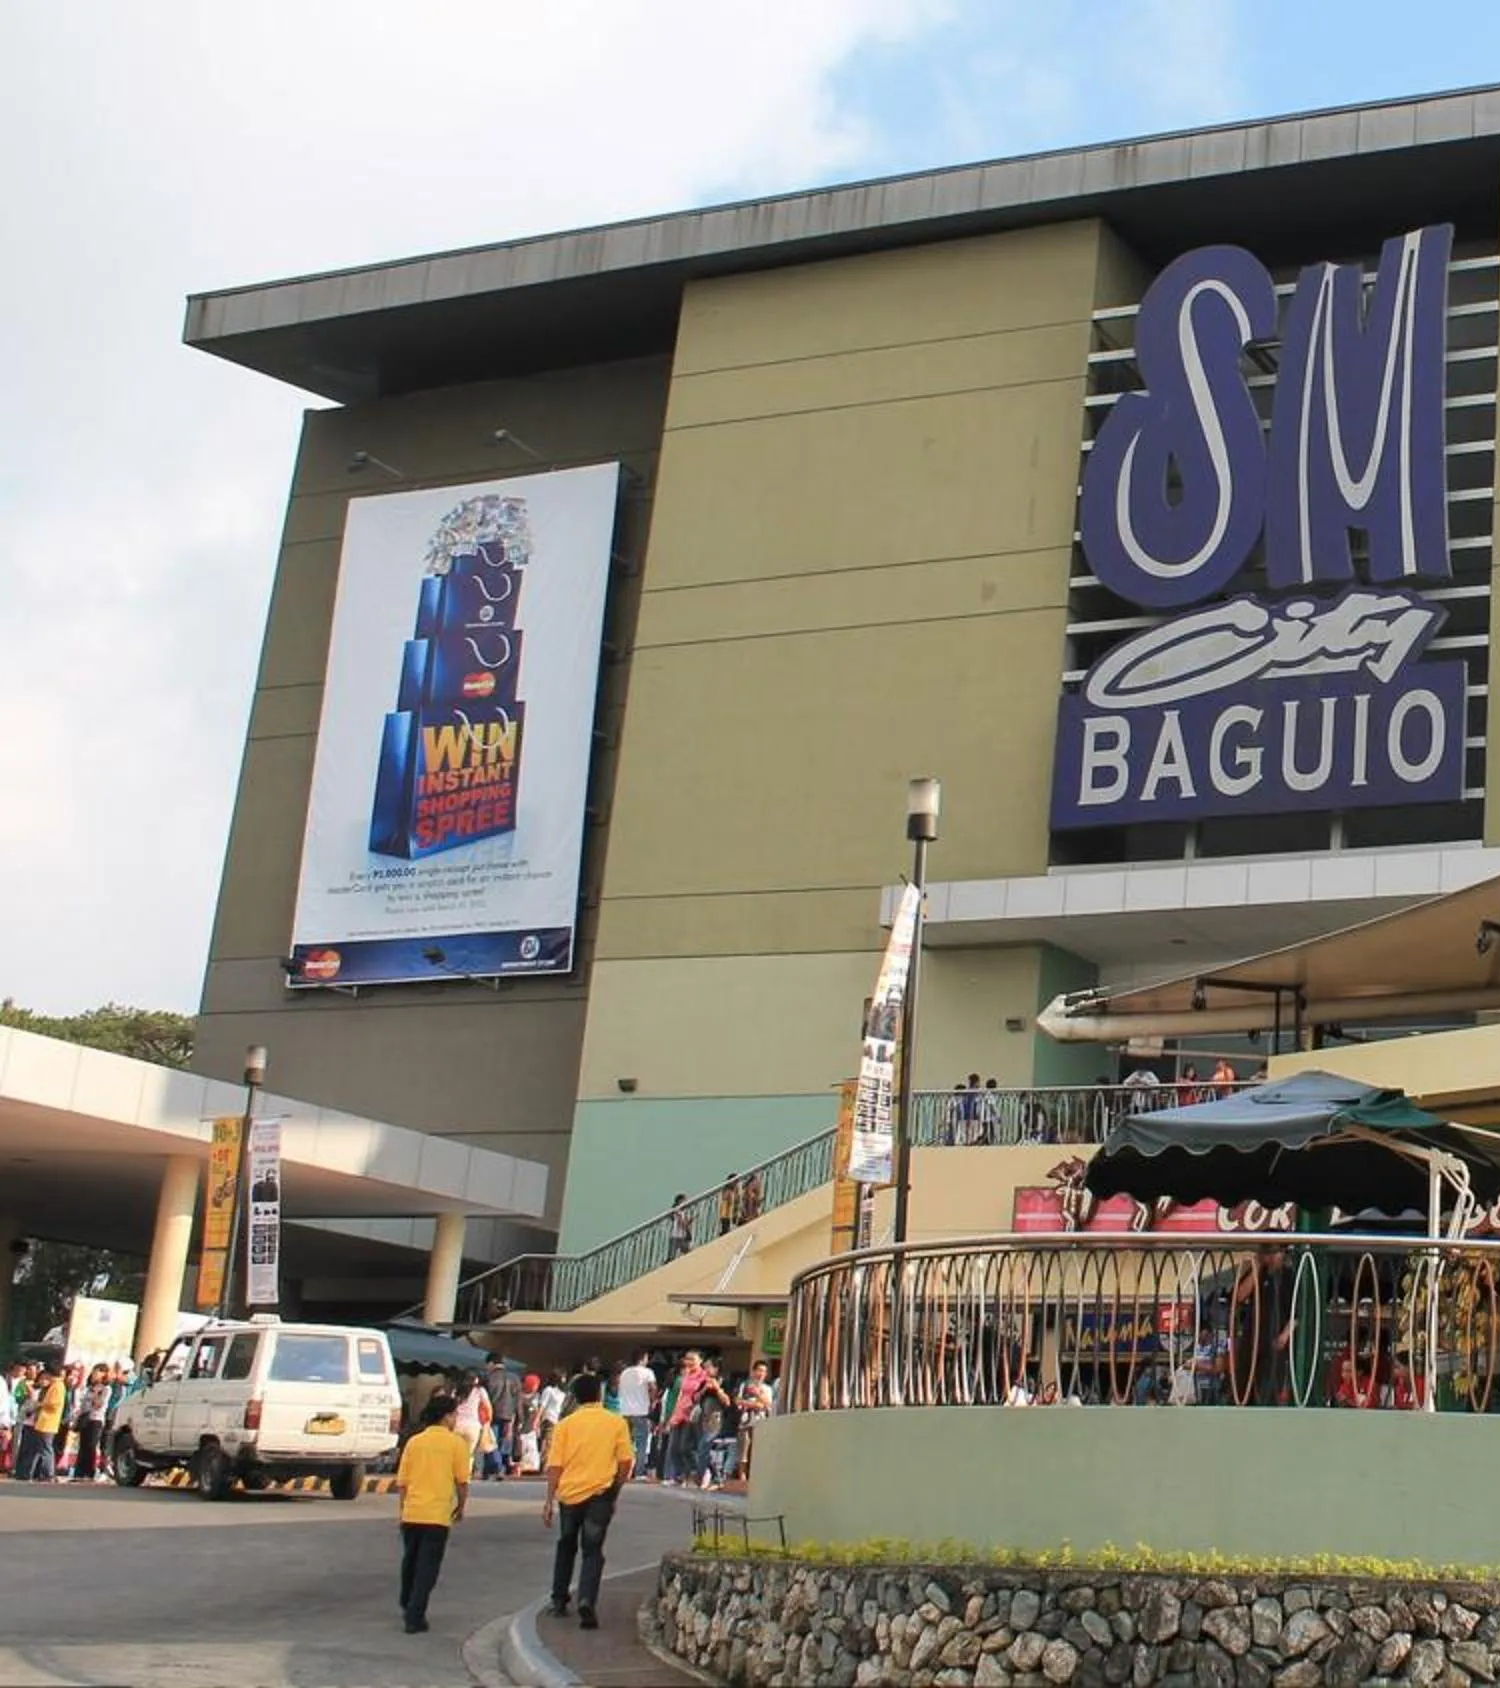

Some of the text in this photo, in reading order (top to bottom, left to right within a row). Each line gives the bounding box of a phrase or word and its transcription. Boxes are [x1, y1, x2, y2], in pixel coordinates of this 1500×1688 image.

[1082, 222, 1455, 607] SM
[1086, 593, 1435, 709] City
[423, 721, 516, 772] WIN
[1077, 689, 1446, 806] BAGUIO
[416, 762, 512, 797] INSTANT
[418, 783, 511, 815] SHOPPING
[416, 801, 509, 849] SPREE
